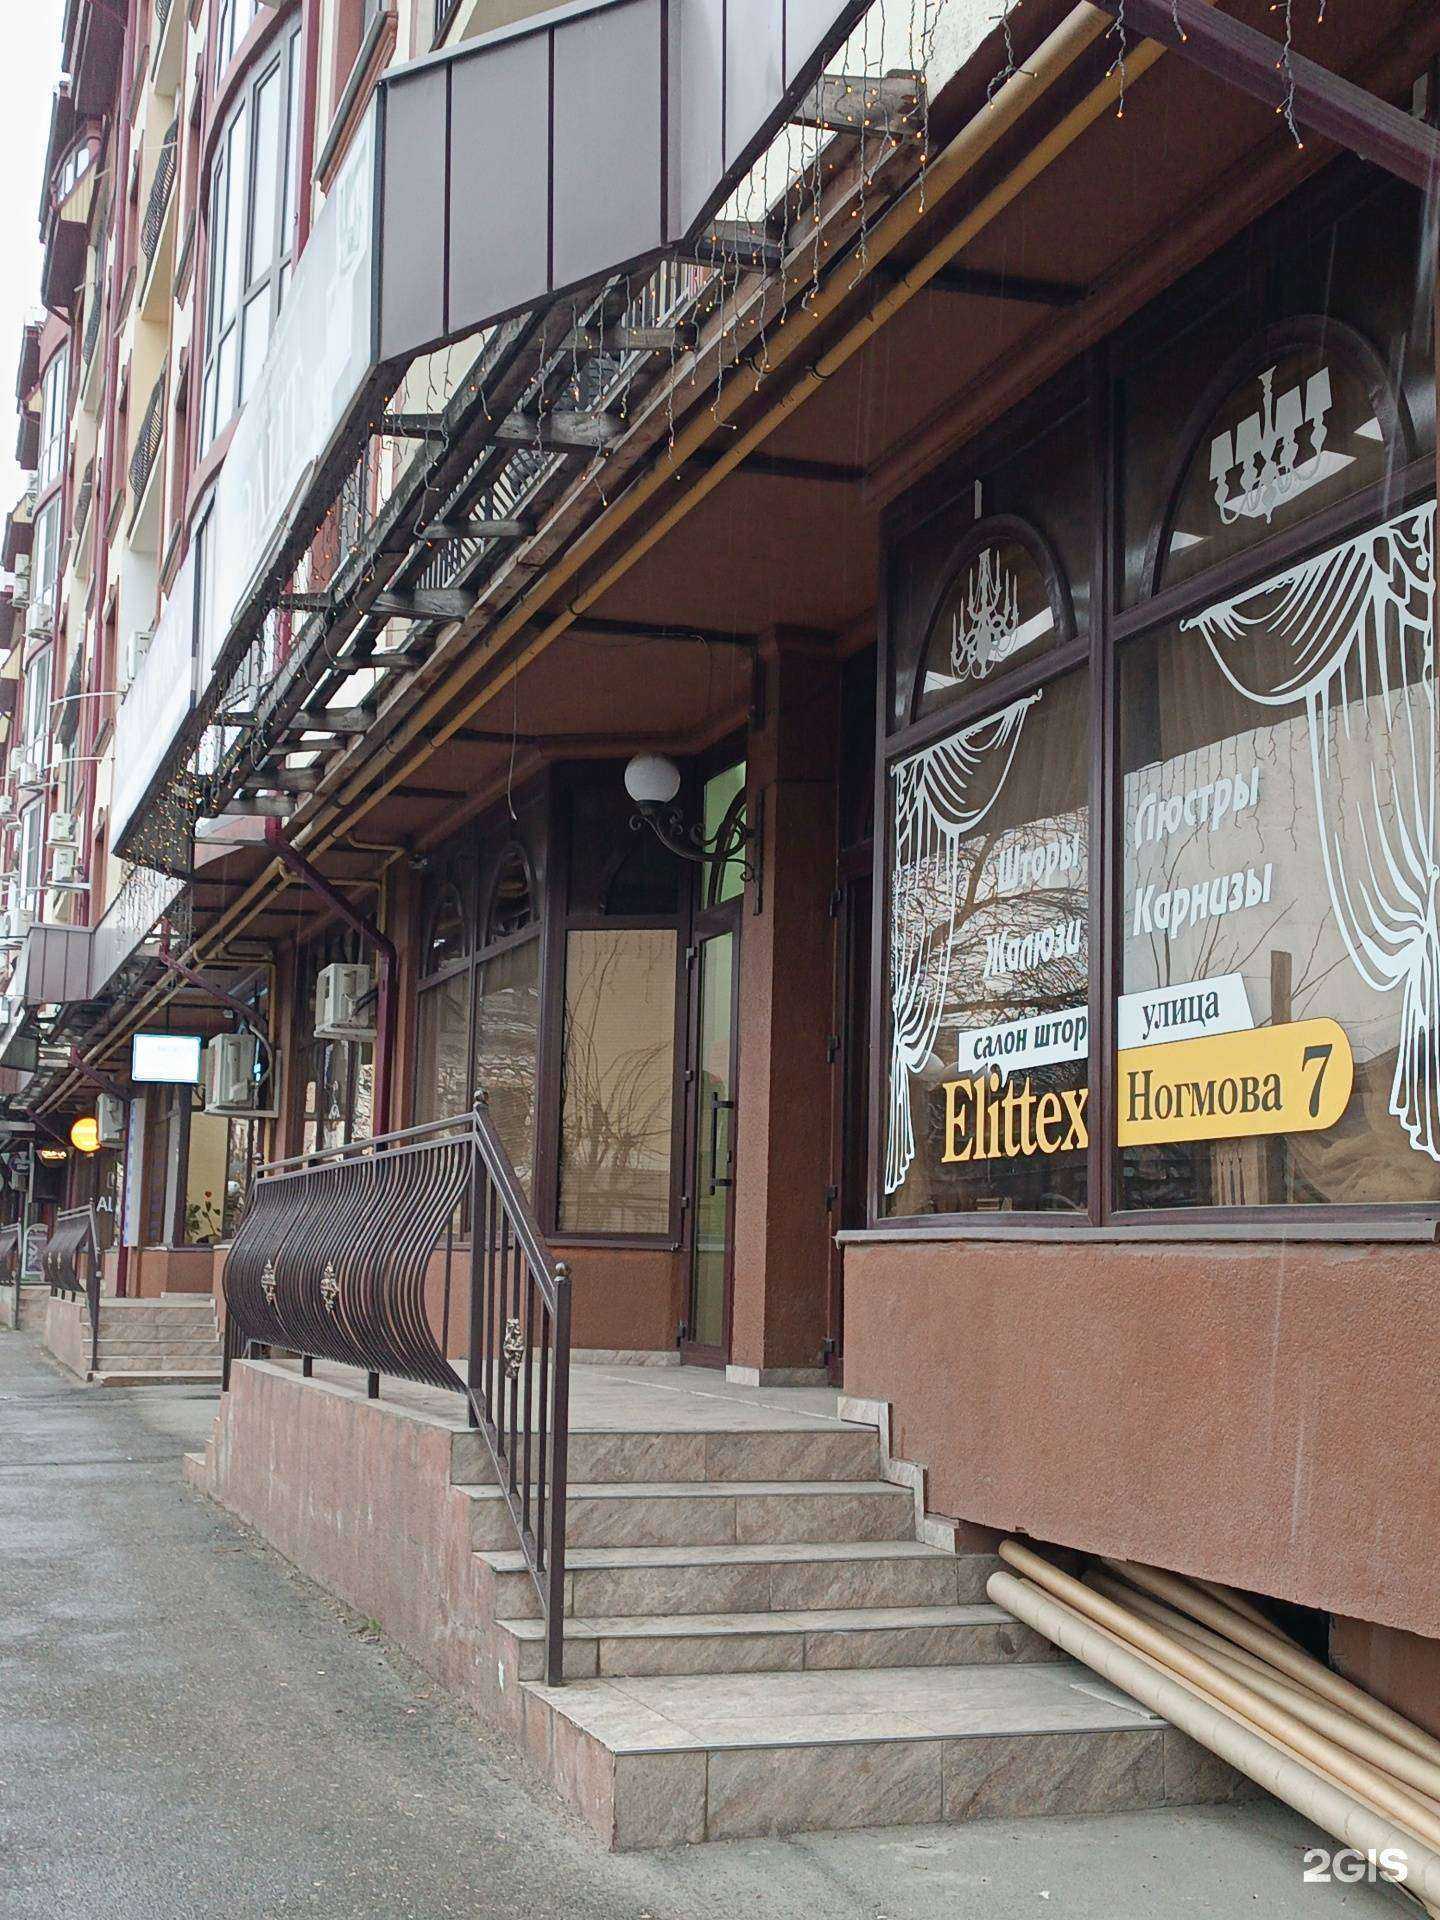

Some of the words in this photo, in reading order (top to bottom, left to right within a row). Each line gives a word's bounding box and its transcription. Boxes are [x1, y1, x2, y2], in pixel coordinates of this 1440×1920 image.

[1135, 767, 1262, 849] Люстры
[998, 833, 1080, 892] Шторы
[1133, 863, 1273, 940] Карнизы
[983, 919, 1082, 980] Жалюзи
[974, 1028, 1027, 1060] салон
[1034, 1016, 1087, 1051] штор
[1141, 991, 1220, 1040] улица
[1126, 1069, 1283, 1122] Ногмова
[1301, 1043, 1333, 1118] 7
[941, 1072, 1088, 1163] Elittex
